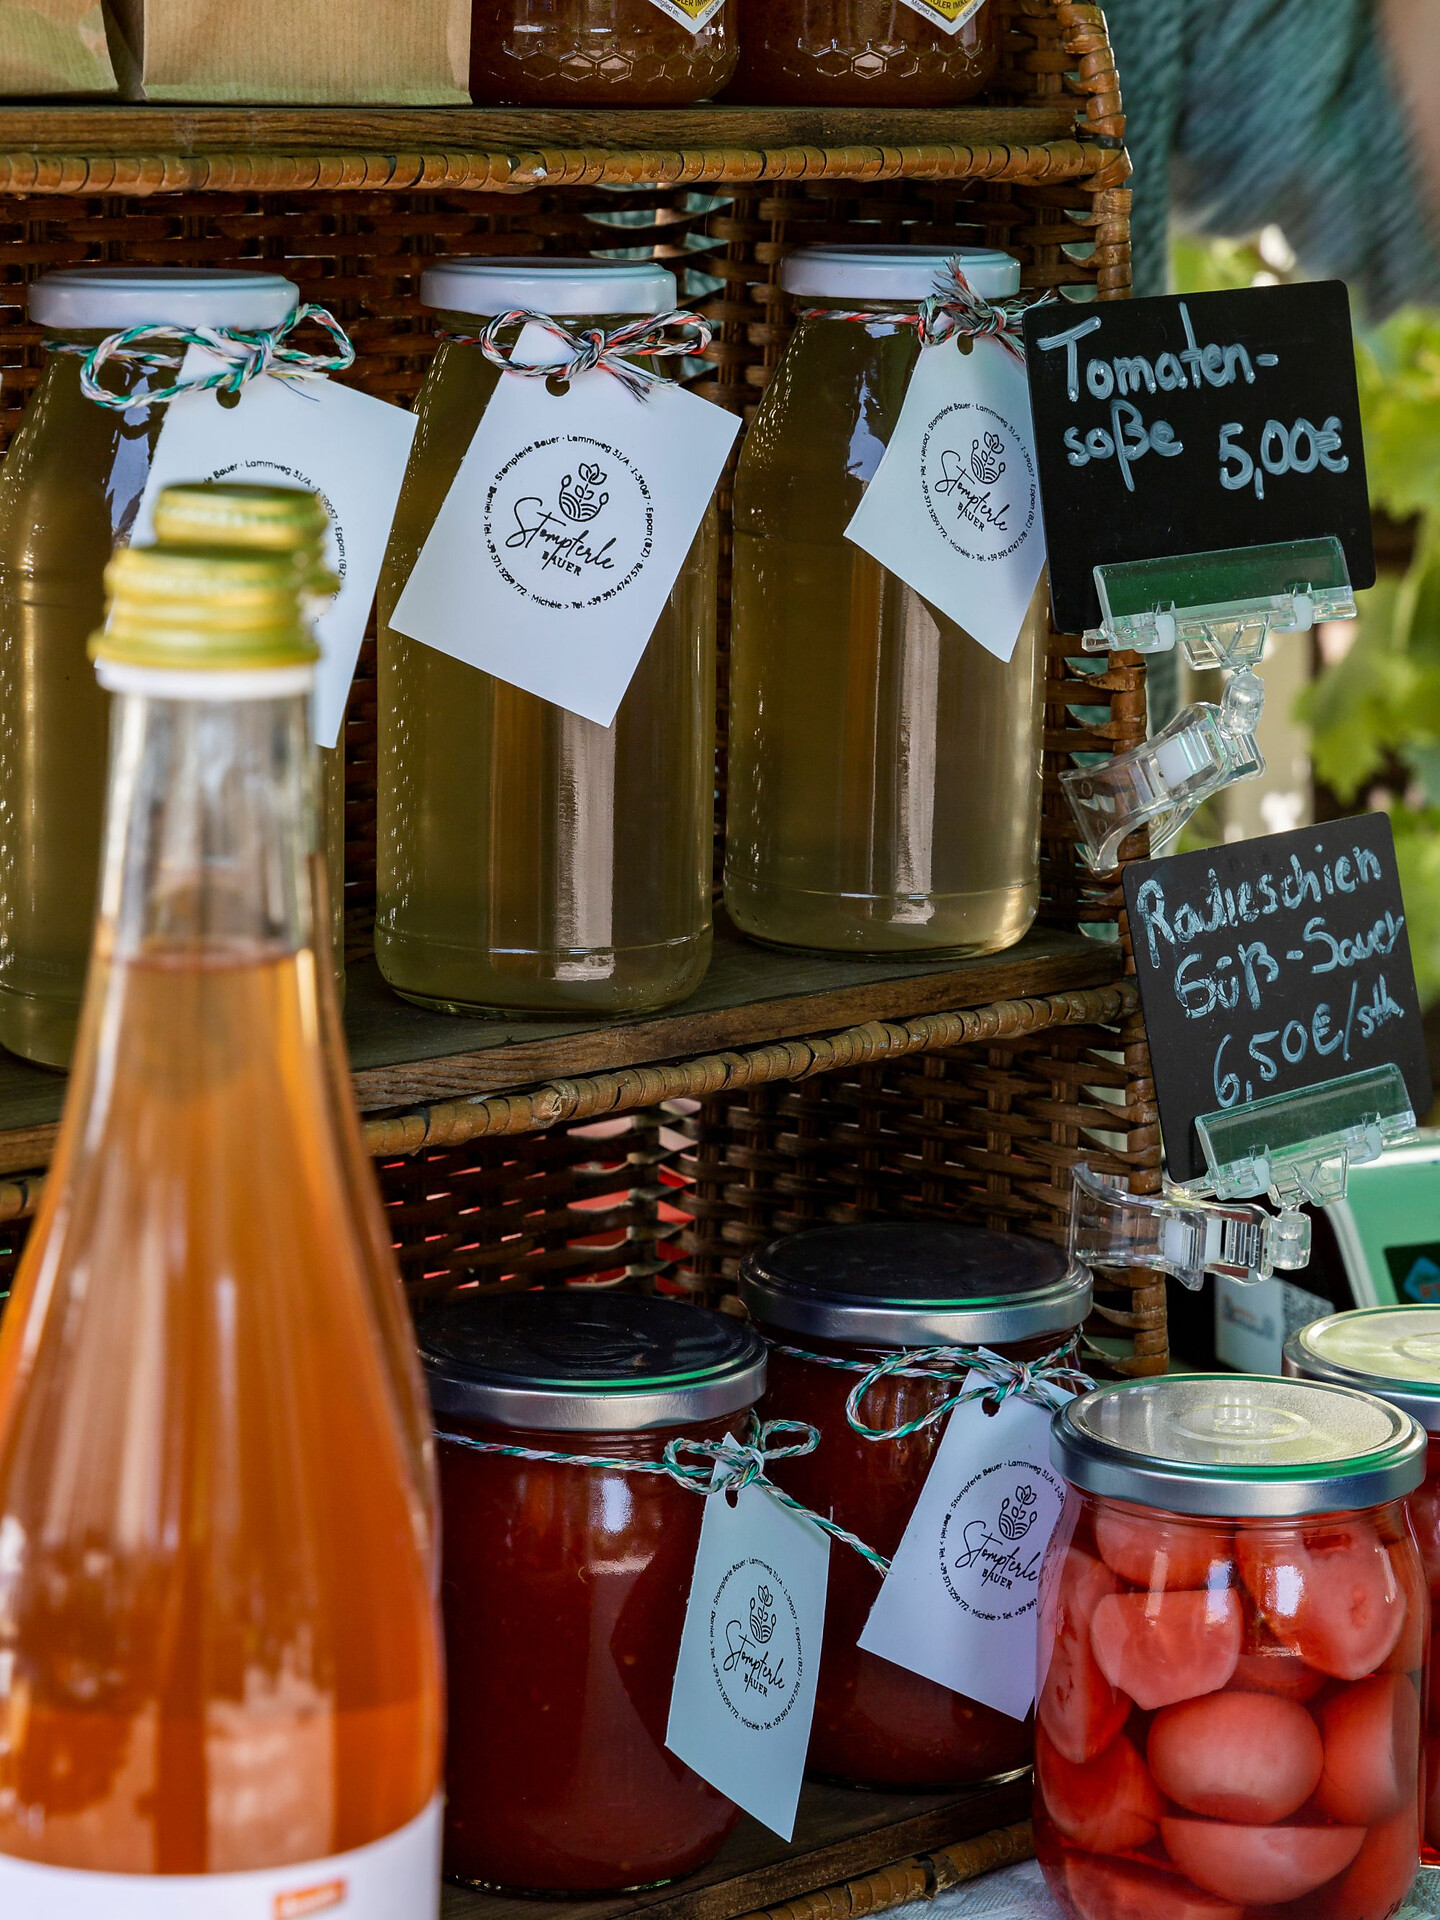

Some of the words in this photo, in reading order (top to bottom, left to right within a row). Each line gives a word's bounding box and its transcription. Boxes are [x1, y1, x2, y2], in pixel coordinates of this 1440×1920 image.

[1036, 301, 1279, 402] Tomaten-
[533, 436, 560, 449] Bauer
[567, 434, 612, 454] Lammweg
[612, 448, 630, 466] 31/A
[928, 405, 953, 431] Stampferle
[953, 402, 971, 411] Bauer
[975, 403, 1009, 428] Lammweg
[1020, 446, 1035, 478] I-39057
[1029, 483, 1037, 510] Eppan
[1063, 398, 1185, 492] soße
[1219, 415, 1350, 500] 5,00€
[494, 446, 533, 481] Stampferle
[212, 463, 238, 479] Bauer
[245, 460, 292, 476] Lammweg
[292, 469, 312, 487] 31/A
[335, 526, 346, 557] Eppan
[645, 507, 654, 536] Eppan
[957, 501, 985, 532] BAUER
[640, 537, 653, 558] (BZ)
[1007, 540, 1020, 554] 4747
[1017, 530, 1028, 544] 578
[483, 522, 492, 537] Tel.
[498, 567, 516, 585] 3259
[513, 582, 528, 597] 772
[571, 601, 585, 610] Tel.
[587, 595, 602, 605] +39
[601, 588, 617, 601] 393
[616, 574, 633, 591] 4747
[630, 562, 644, 577] 578
[541, 550, 582, 577] BAUER
[950, 1474, 982, 1509] Stampferle
[982, 1462, 1003, 1476] Bauer
[1008, 1459, 1042, 1475] Lammweg
[713, 1569, 733, 1606] Stampferle
[732, 1559, 746, 1572] Bauer
[981, 1568, 1013, 1590] BAUER
[744, 1672, 768, 1698] BAUER
